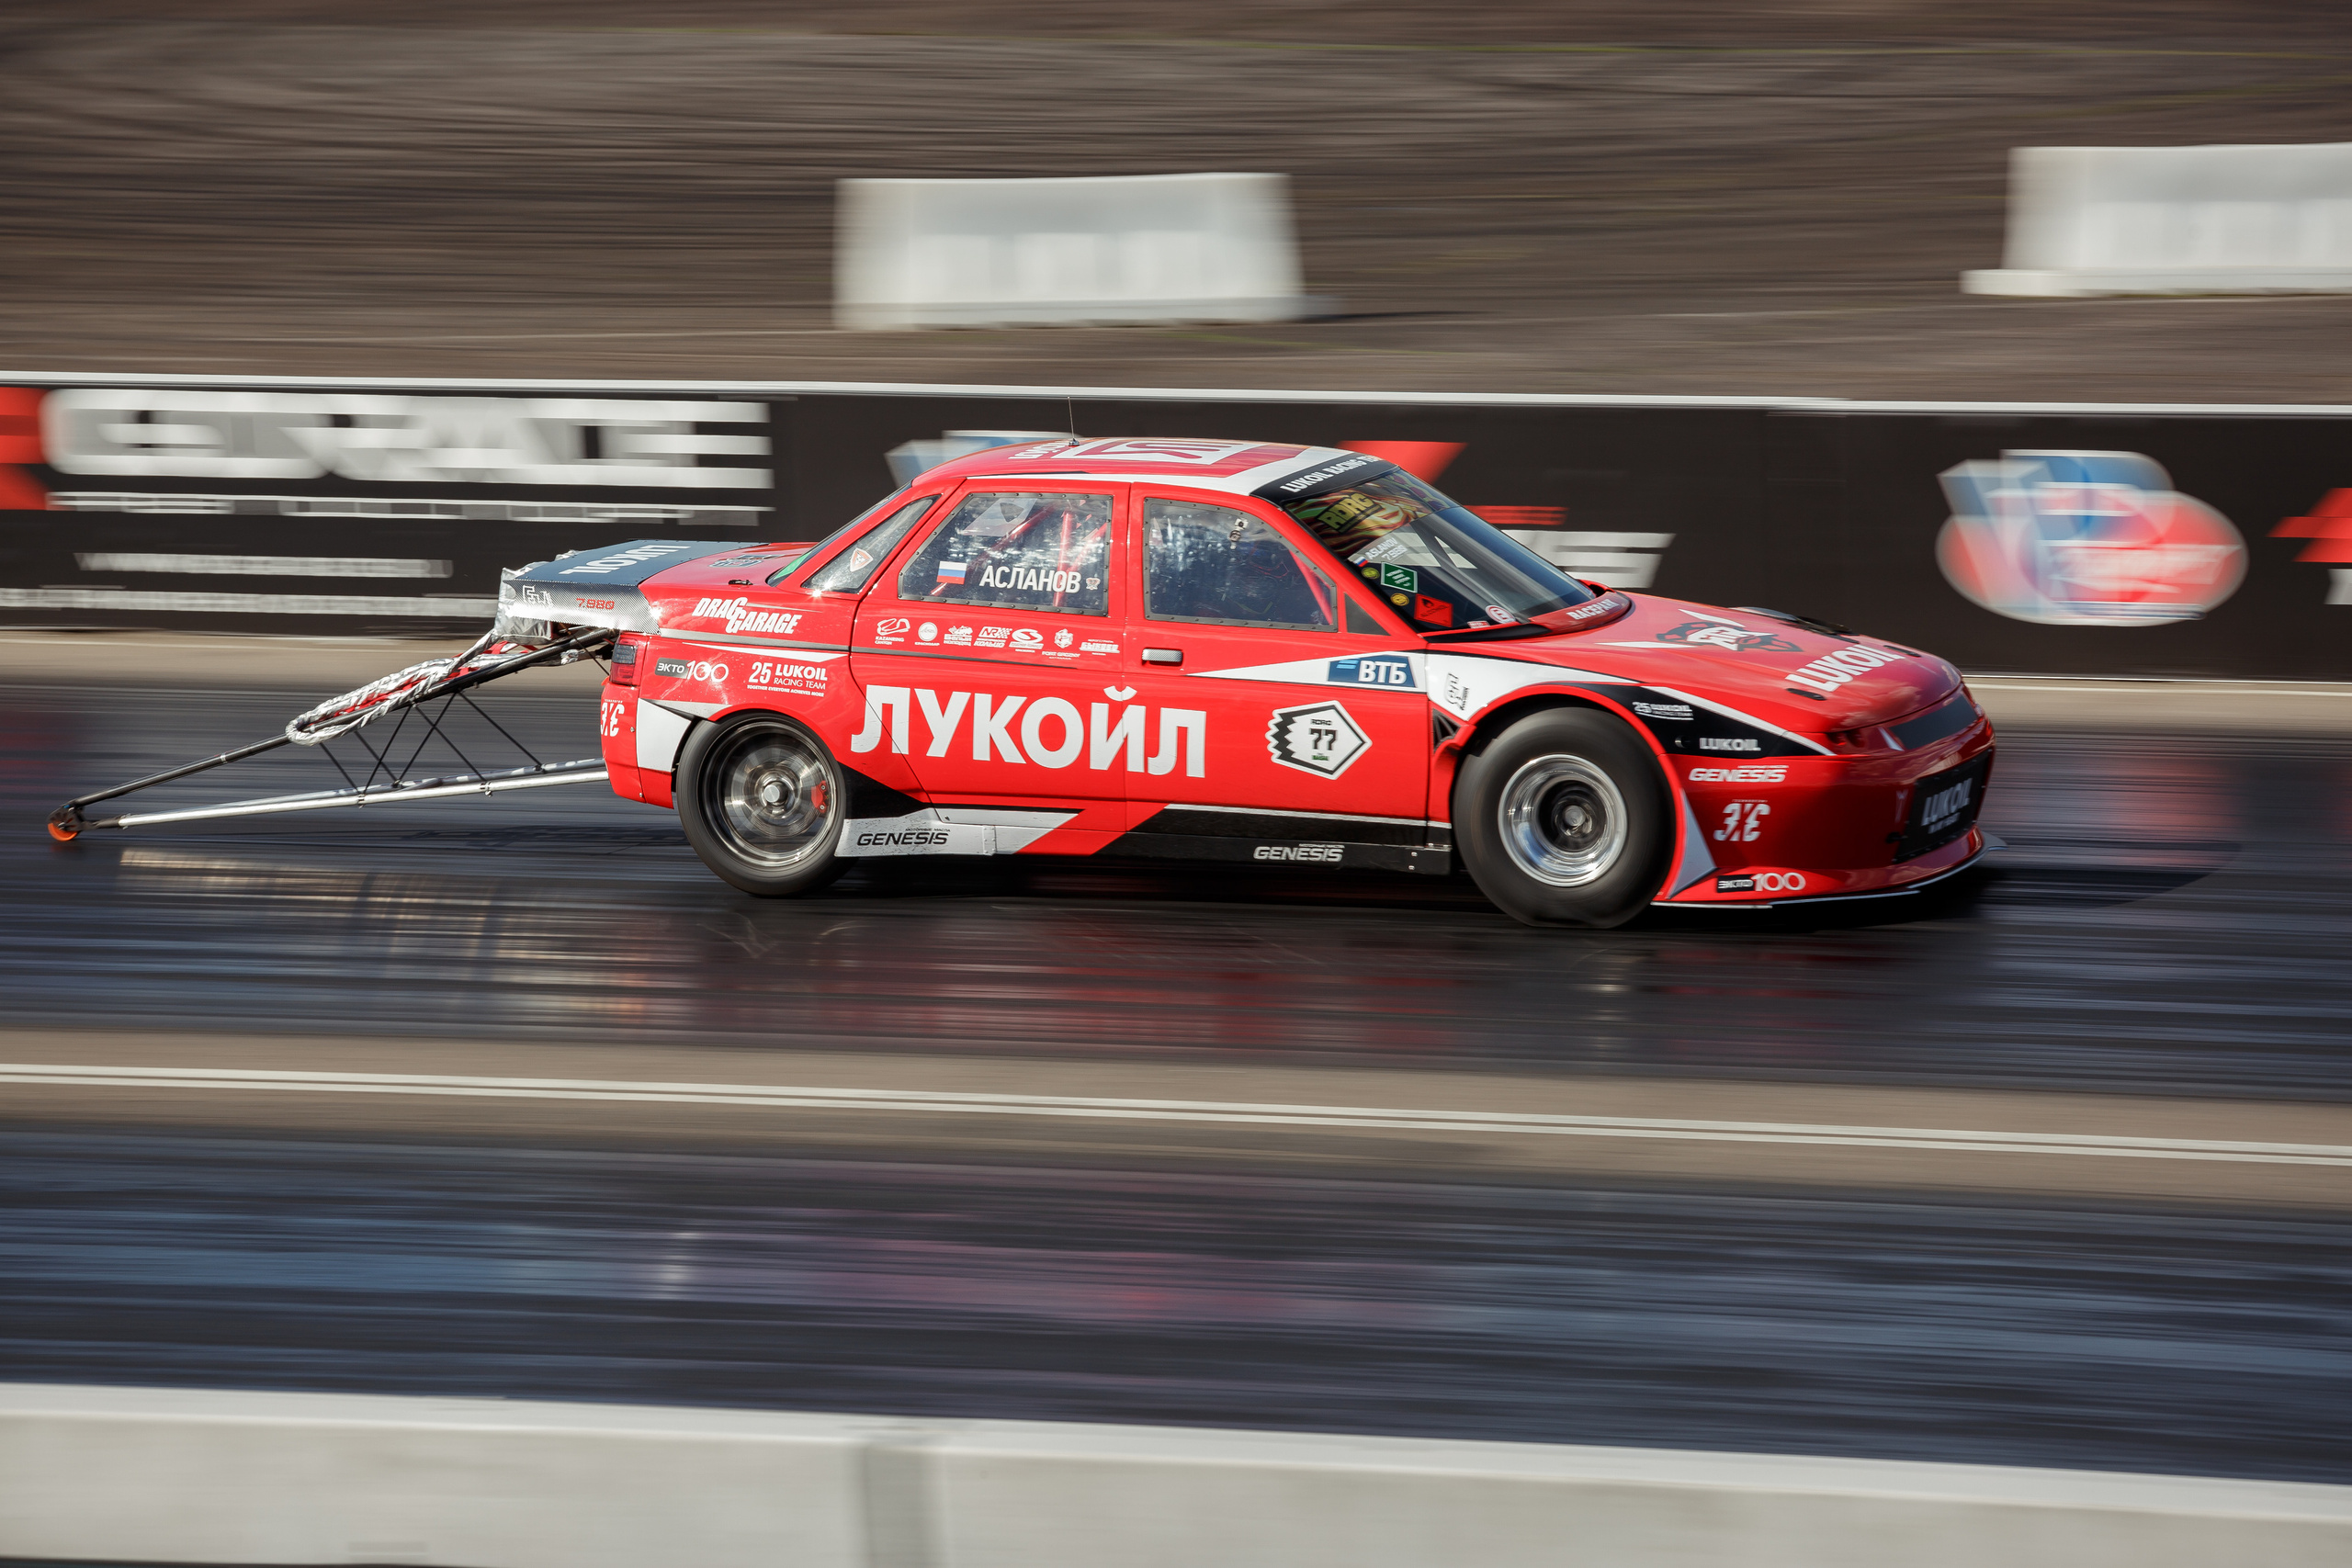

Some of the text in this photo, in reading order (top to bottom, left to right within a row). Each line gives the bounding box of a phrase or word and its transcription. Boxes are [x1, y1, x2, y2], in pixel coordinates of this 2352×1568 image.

[1280, 471, 1334, 492] LUKOIL
[1322, 458, 1367, 475] RACING
[1316, 492, 1376, 529] RDRC
[559, 545, 691, 574] LUKOIL
[1364, 537, 1398, 560] ASLANOV
[979, 565, 1082, 593] АСЛАНОВ
[576, 598, 615, 610] 7.980
[692, 597, 748, 620] DRAG
[725, 607, 802, 634] GARAGE
[657, 662, 684, 674] ЭКТО
[686, 660, 729, 682] 100
[748, 661, 828, 683] 25 LUKOIL
[1358, 660, 1408, 684] ВТБ
[1785, 644, 1906, 693] LUKOIL
[773, 677, 826, 690] RACING TEAM
[851, 684, 1207, 778] ЛУКОЙЛ
[1309, 728, 1338, 750] 77
[1699, 738, 1762, 751] LUKOIL
[1688, 768, 1788, 783] GENESIS
[857, 832, 949, 846] GENESIS
[1253, 846, 1344, 862] GENESIS
[1750, 872, 1806, 891] 100
